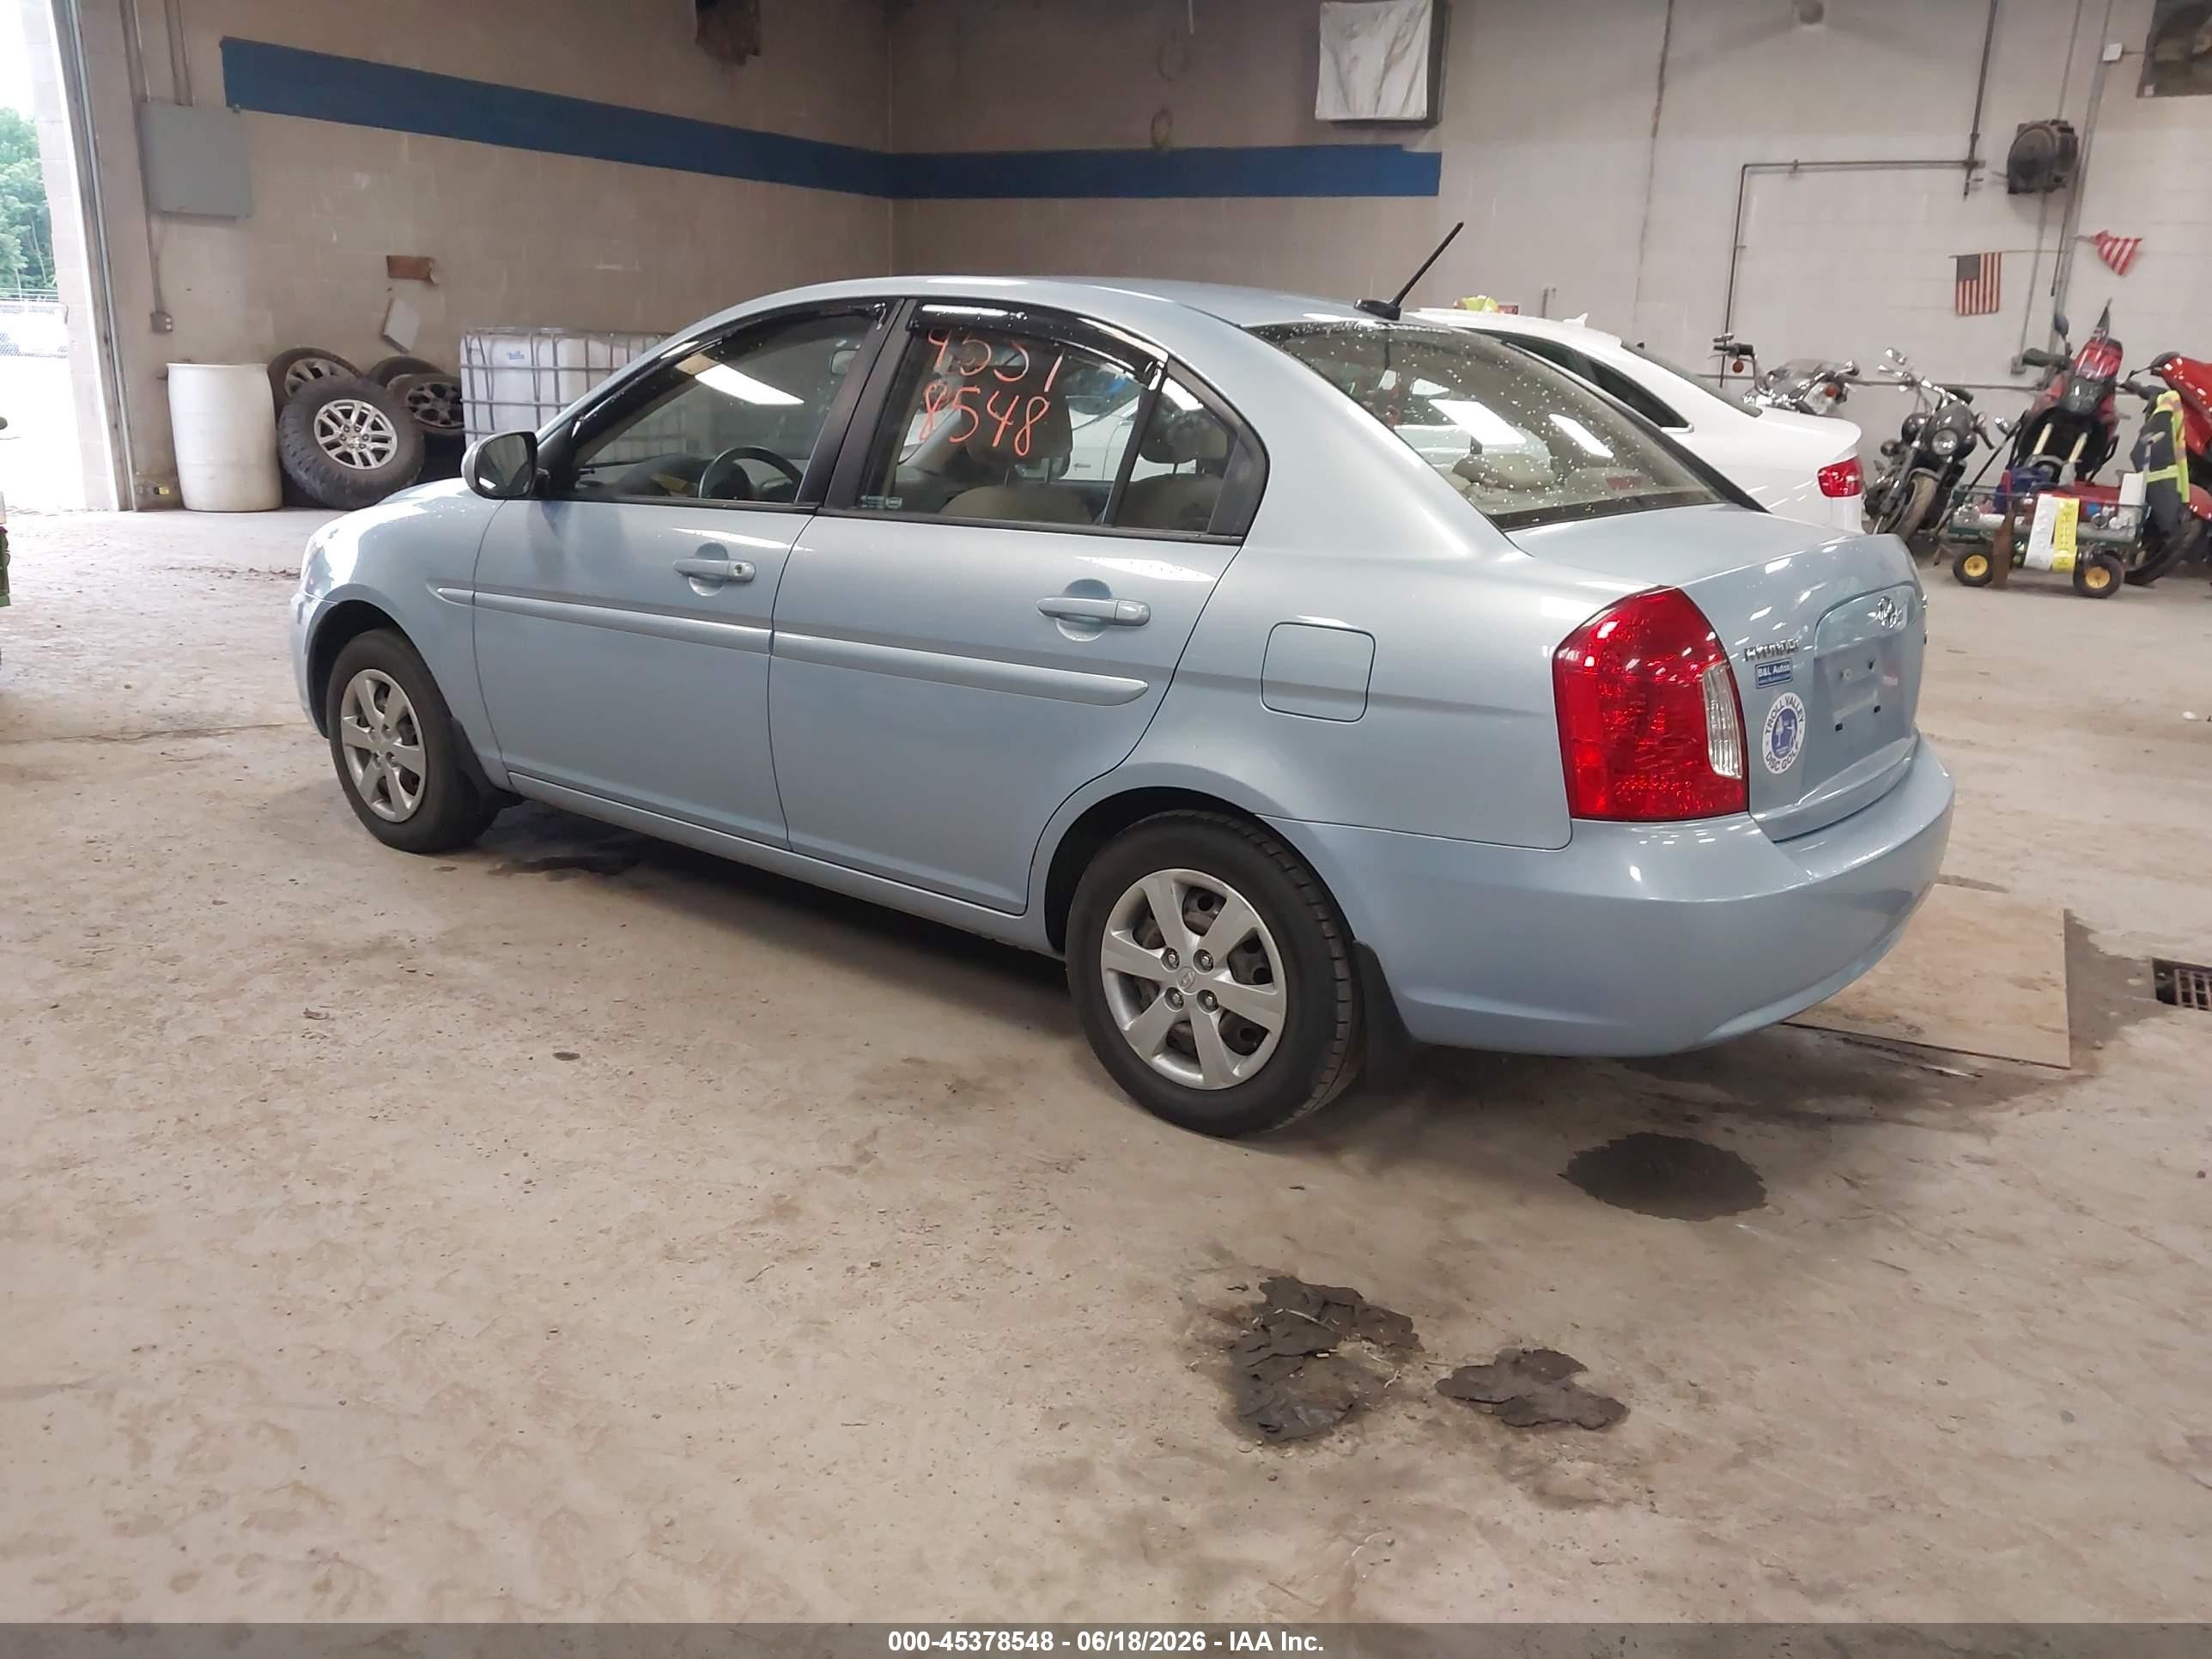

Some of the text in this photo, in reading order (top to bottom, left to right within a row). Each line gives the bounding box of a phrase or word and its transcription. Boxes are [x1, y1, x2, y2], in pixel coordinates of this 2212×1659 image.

[919, 380, 1051, 456] 8548
[1765, 696, 1805, 735] TROLL VALLEY
[1765, 750, 1781, 771] DISC
